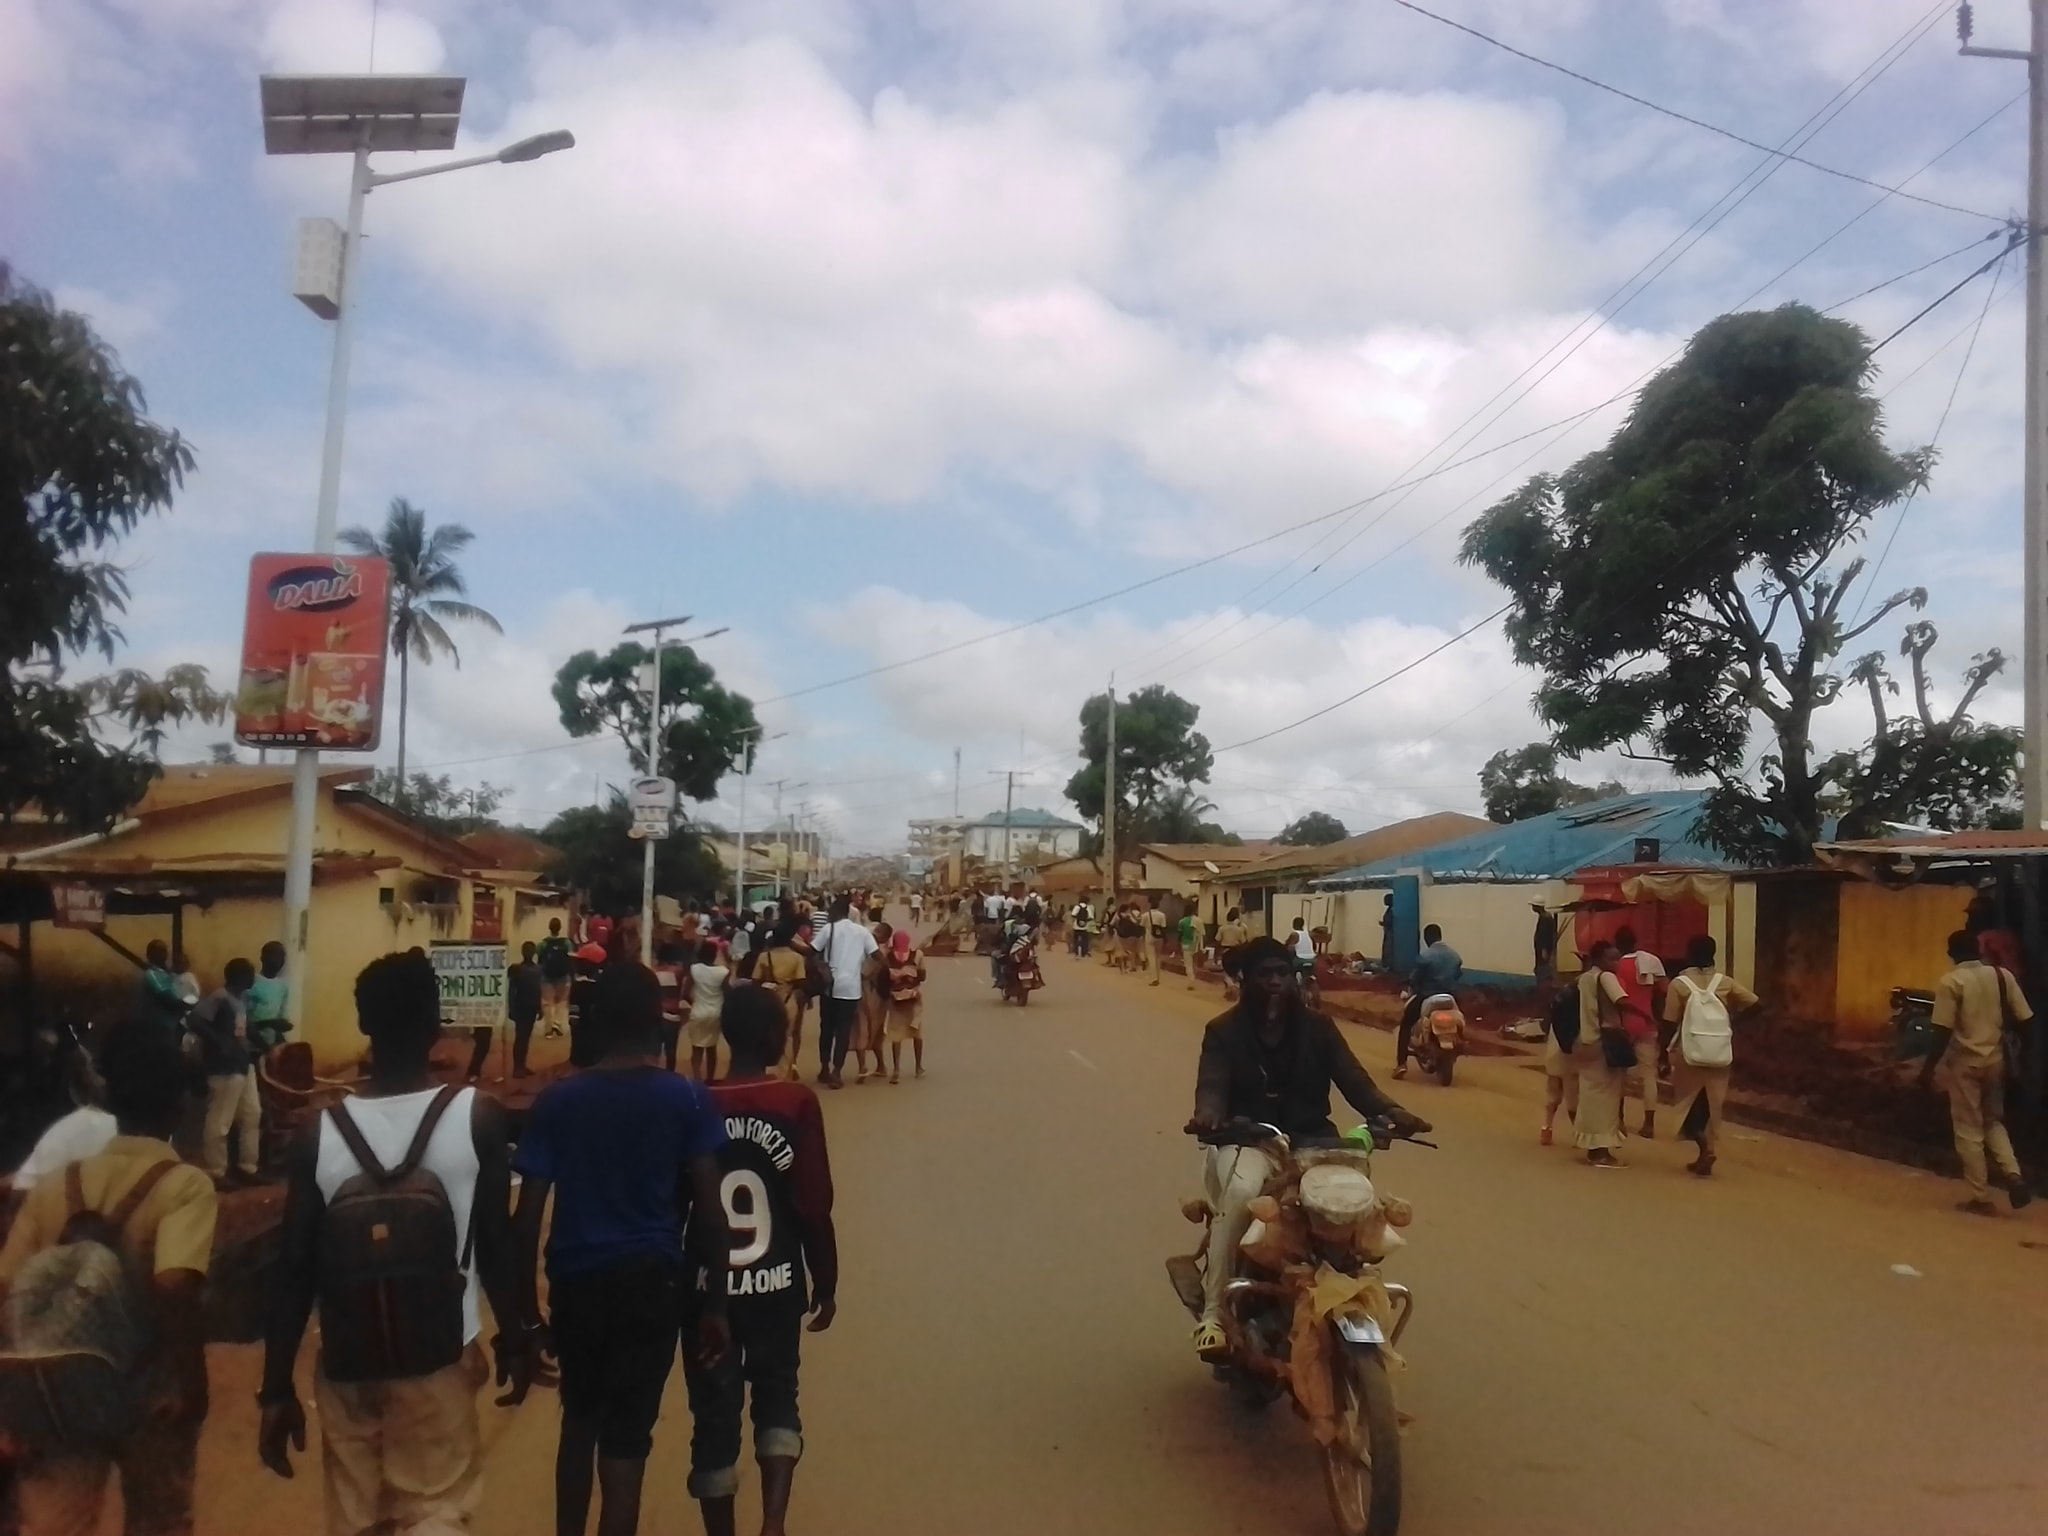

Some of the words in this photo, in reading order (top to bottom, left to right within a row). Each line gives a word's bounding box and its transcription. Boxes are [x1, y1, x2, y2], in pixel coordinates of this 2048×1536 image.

[274, 573, 362, 611] DALIA
[745, 1117, 786, 1155] FORCE
[720, 1169, 772, 1266] 9
